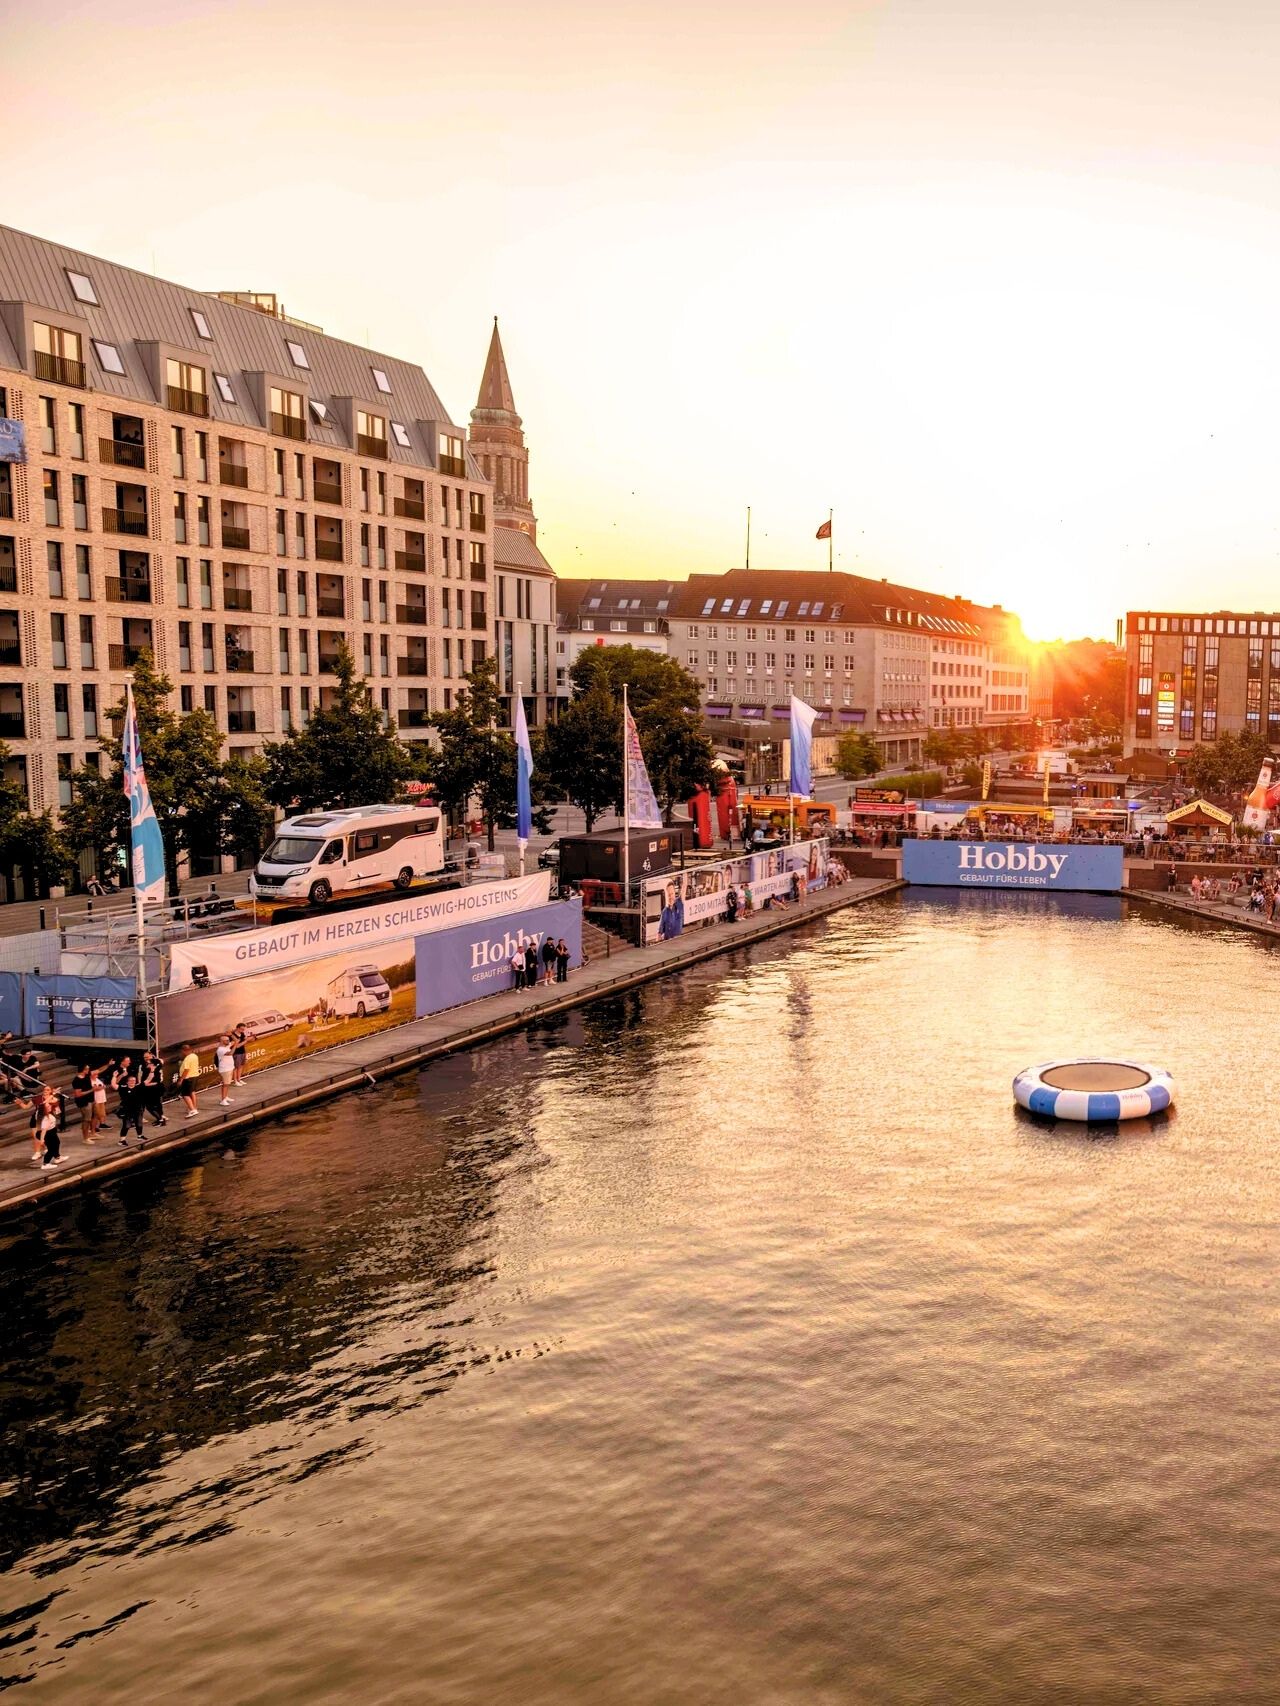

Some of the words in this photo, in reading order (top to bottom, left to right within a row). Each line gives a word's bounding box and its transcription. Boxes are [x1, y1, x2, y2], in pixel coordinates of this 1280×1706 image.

[957, 844, 1069, 879] Hobby
[960, 873, 995, 883] GEBAUT
[995, 874, 1018, 884] FÜRS
[1019, 876, 1047, 885] LEBEN
[235, 933, 299, 960] GEBAUT
[303, 928, 320, 945] IM
[326, 916, 381, 941] HERZEN
[384, 888, 519, 927] SCHLESWIG-HOLSTEINS
[471, 968, 496, 983] GEBAUT
